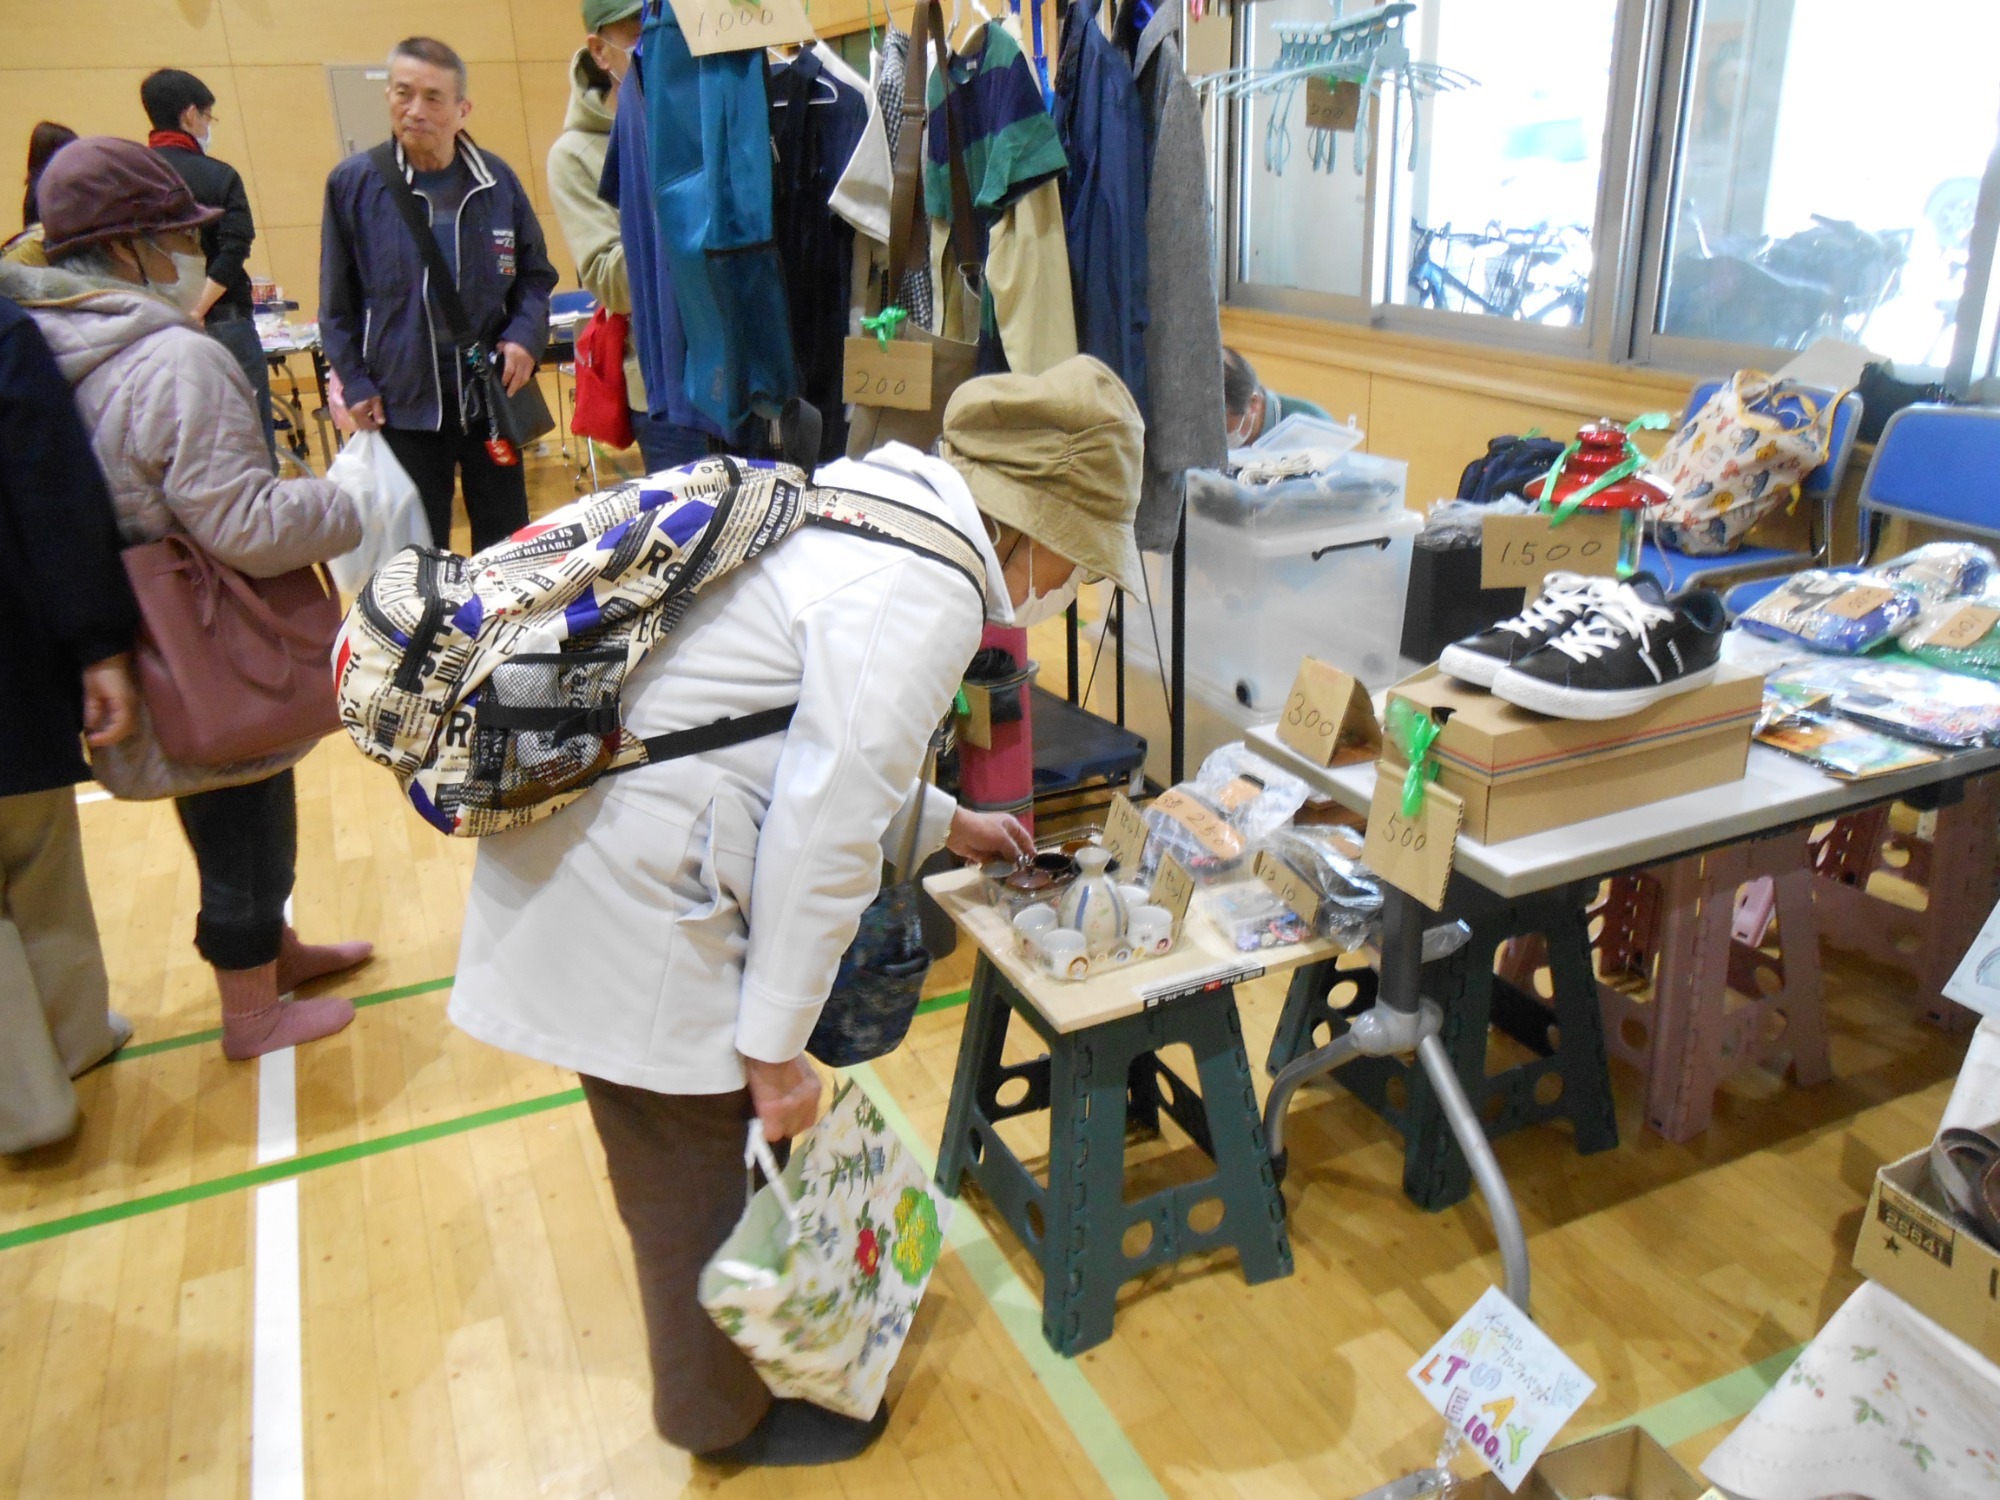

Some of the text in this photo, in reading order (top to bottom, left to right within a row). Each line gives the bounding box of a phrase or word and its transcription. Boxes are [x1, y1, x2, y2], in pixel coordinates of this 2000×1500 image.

[853, 370, 907, 396] 200
[1287, 691, 1335, 738] 300
[1382, 811, 1427, 852] 500
